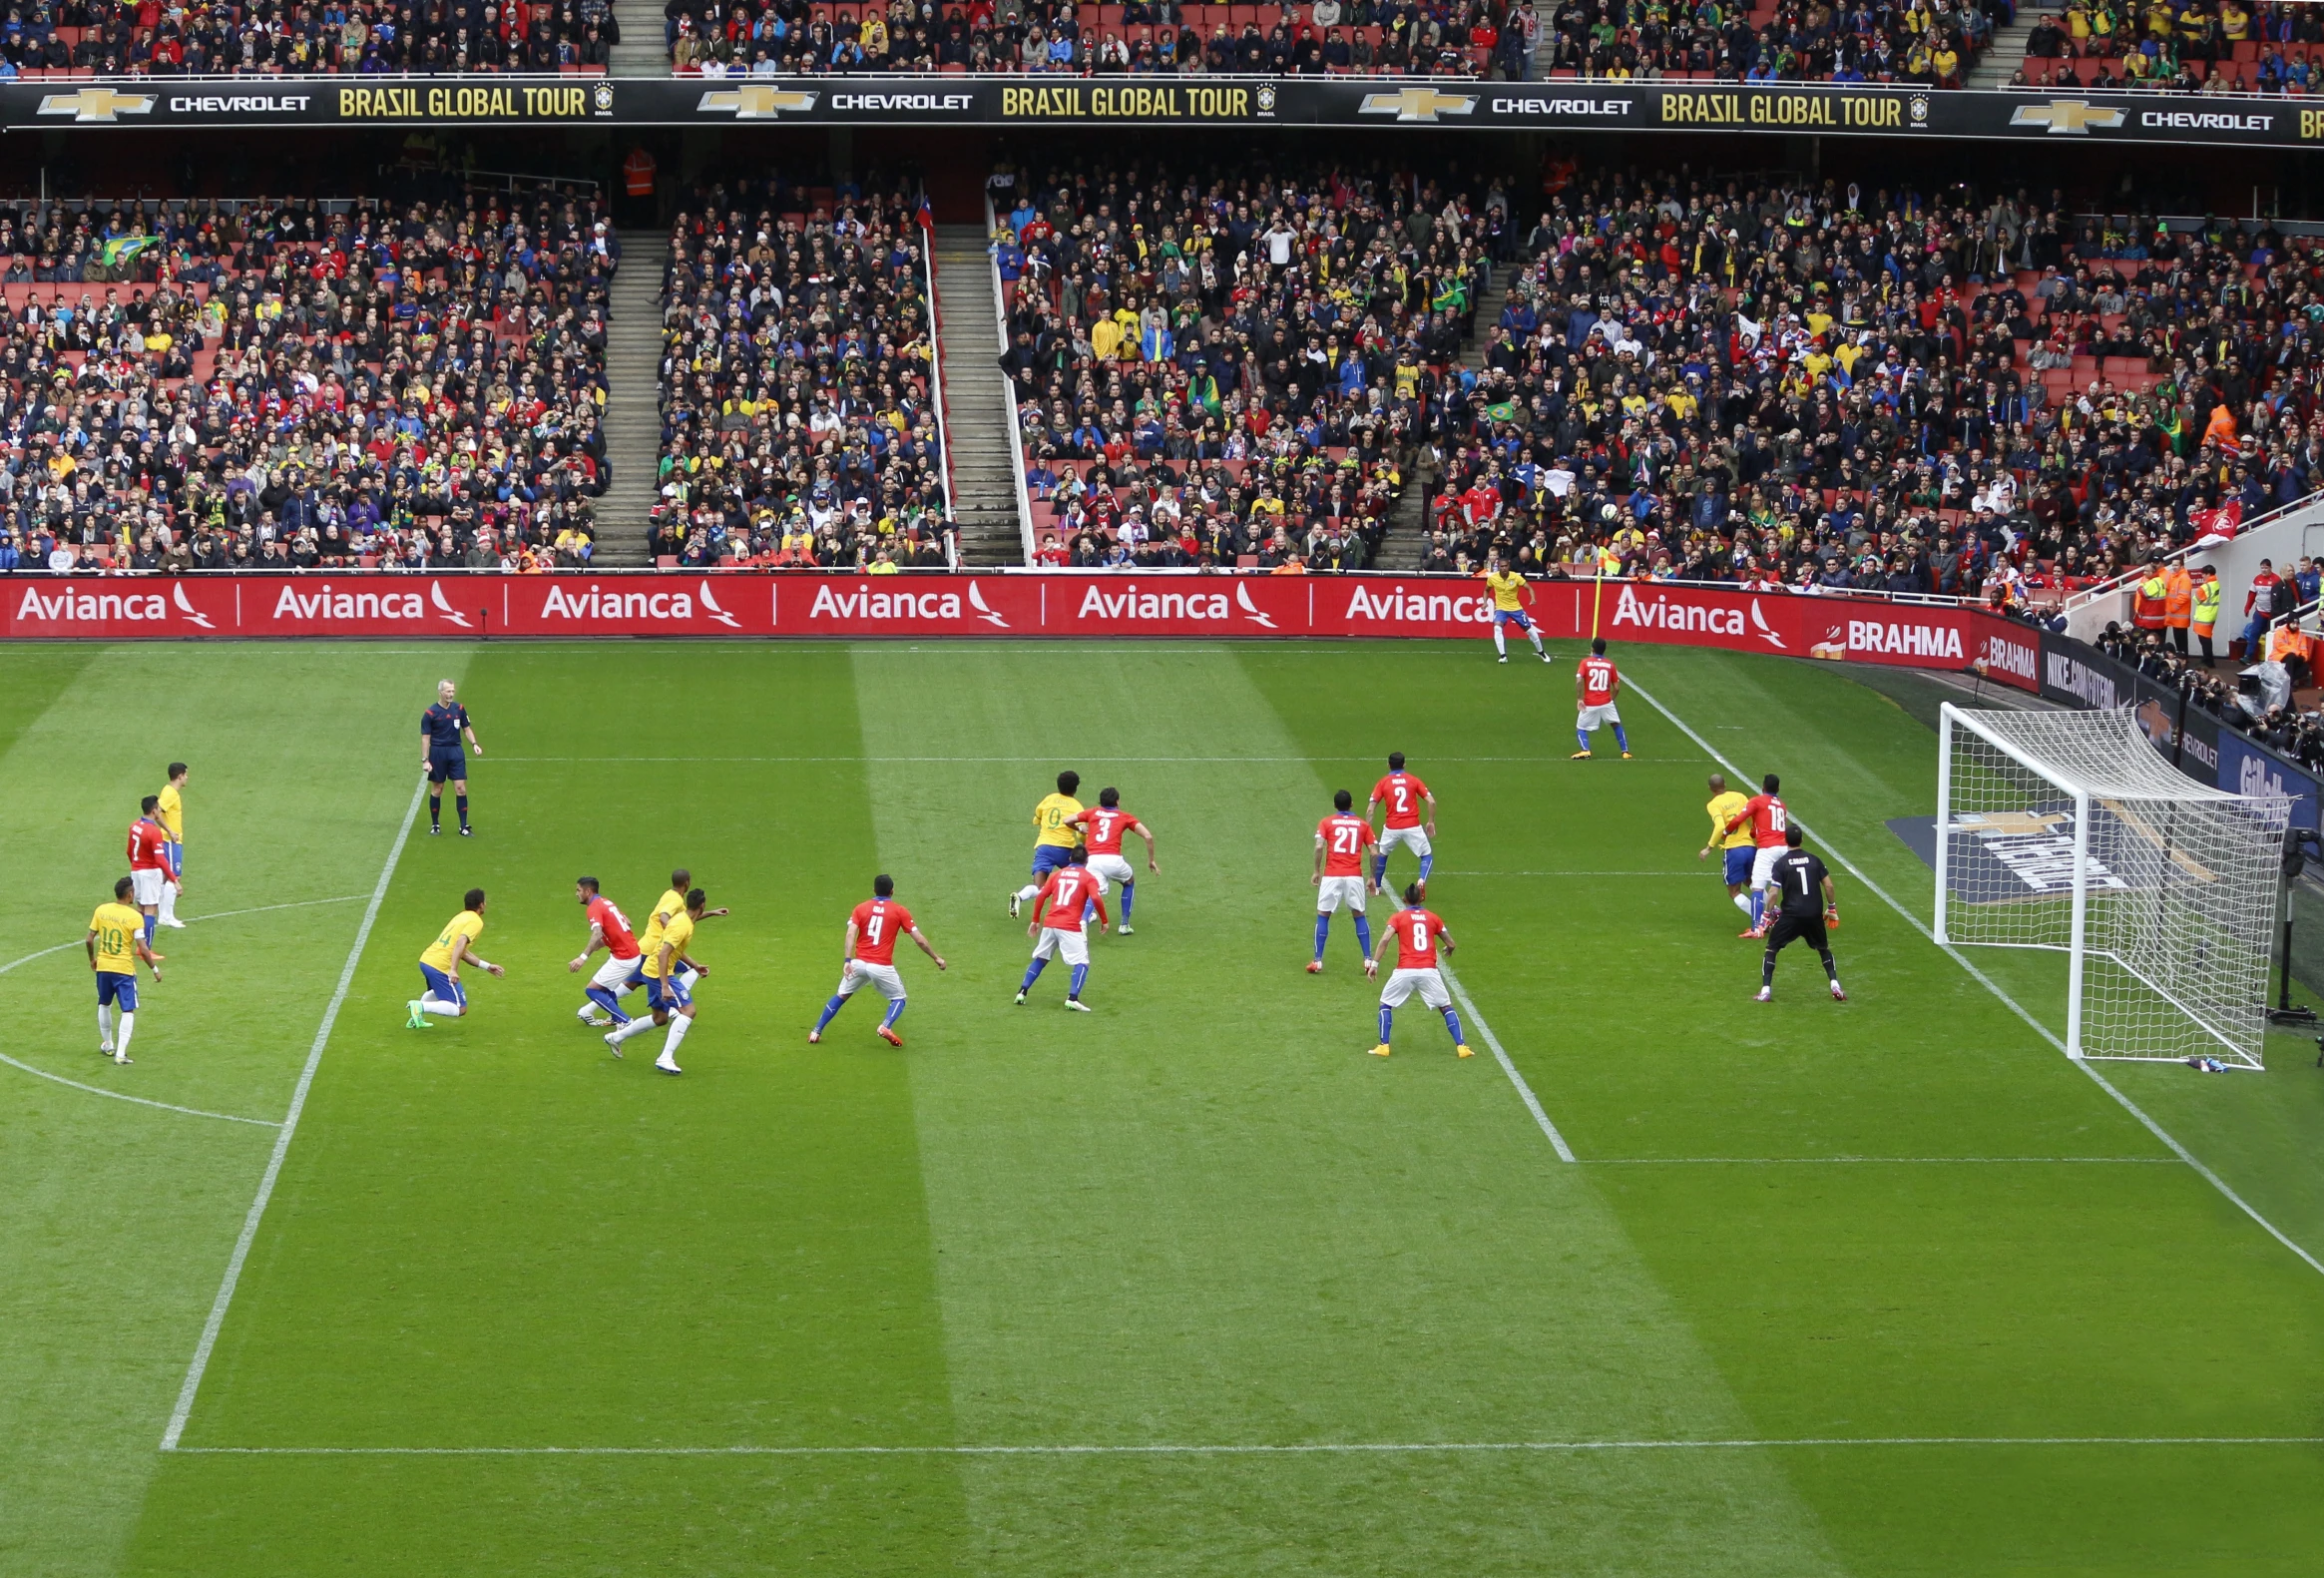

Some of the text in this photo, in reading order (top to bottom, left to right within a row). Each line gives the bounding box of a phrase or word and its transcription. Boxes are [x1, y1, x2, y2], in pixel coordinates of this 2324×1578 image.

[170, 96, 311, 112] CHEVROLET
[428, 87, 519, 117] GLOBAL
[522, 87, 586, 116] TOUR
[831, 94, 974, 110] CHEVROLET
[1091, 87, 1181, 117] GLOBAL
[1184, 87, 1248, 117] TOUR
[1492, 98, 1633, 115] CHEVROLET
[1750, 95, 1837, 125] GLOBAL
[1840, 97, 1902, 126] TOUR
[2141, 111, 2274, 131] CHEVROLET
[16, 586, 167, 621] Avianca
[272, 584, 424, 620] Avianca
[540, 584, 693, 619] Avianca
[809, 584, 961, 619] Avianca
[1077, 584, 1228, 620] Avianca
[1345, 585, 1496, 624] Avianca
[1612, 585, 1746, 636] Avianca
[1848, 620, 1964, 659] BRAHMA
[1989, 636, 2037, 681] BRAHMA
[1588, 668, 1610, 692] 20
[1394, 786, 1409, 812] 2
[1049, 807, 1061, 830] 9
[1095, 816, 1112, 843] 3
[1767, 804, 1786, 832] 18
[132, 833, 142, 861] 7
[1333, 826, 1358, 854] 21
[1057, 879, 1079, 906] 17
[1796, 866, 1809, 895] 1
[102, 928, 123, 955] 10
[867, 915, 884, 946] 4
[1413, 922, 1428, 951] 8
